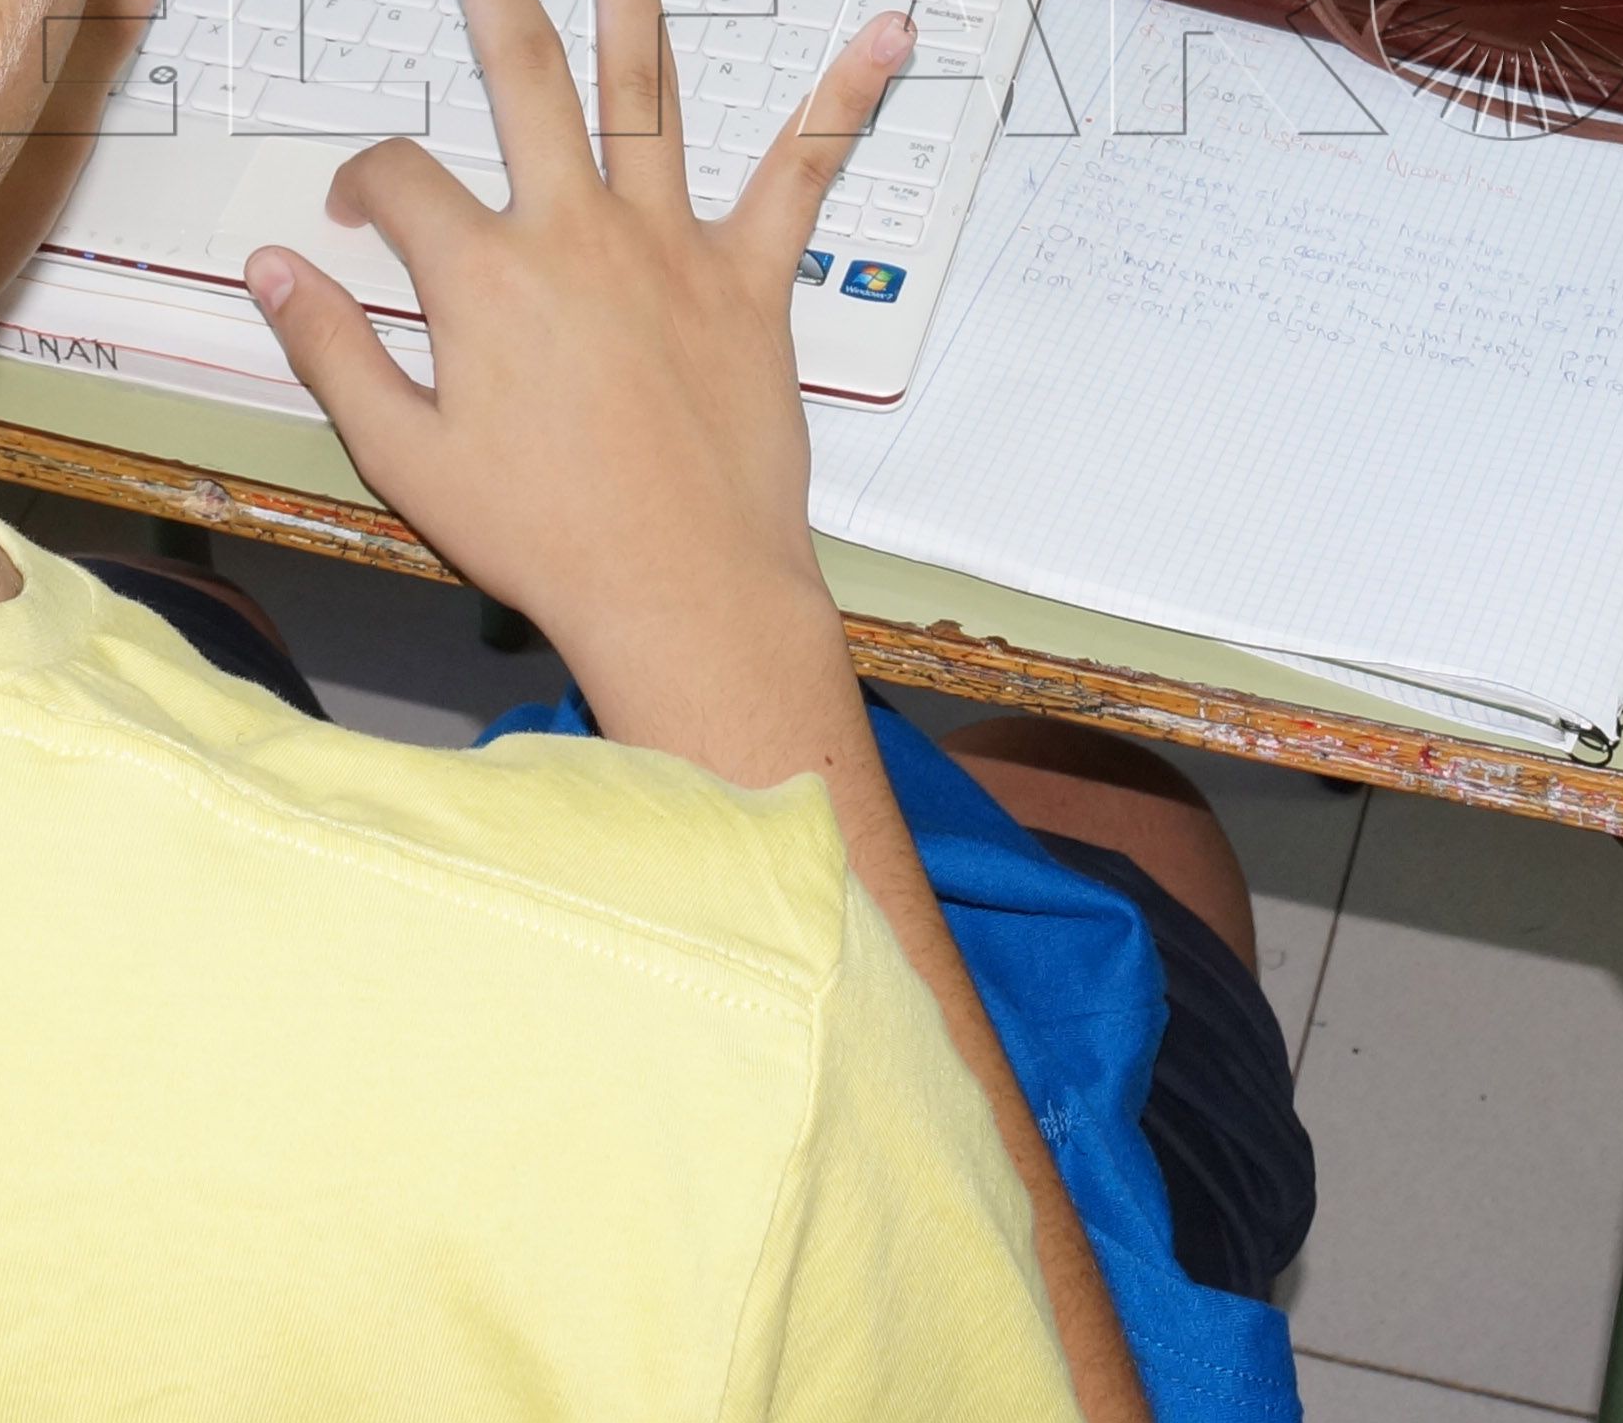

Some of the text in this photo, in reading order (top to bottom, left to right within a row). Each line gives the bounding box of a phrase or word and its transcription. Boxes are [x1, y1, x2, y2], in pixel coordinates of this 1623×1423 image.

[387, 9, 401, 22] G
[925, 6, 985, 25] Backspace
[208, 24, 223, 36] X
[725, 19, 738, 31] P
[273, 35, 288, 48] C
[338, 46, 353, 58] V
[404, 58, 417, 70] B
[936, 55, 968, 68] Enter
[719, 62, 734, 77] Ñ
[908, 141, 937, 154] Shift
[698, 164, 721, 177] Ctrl
